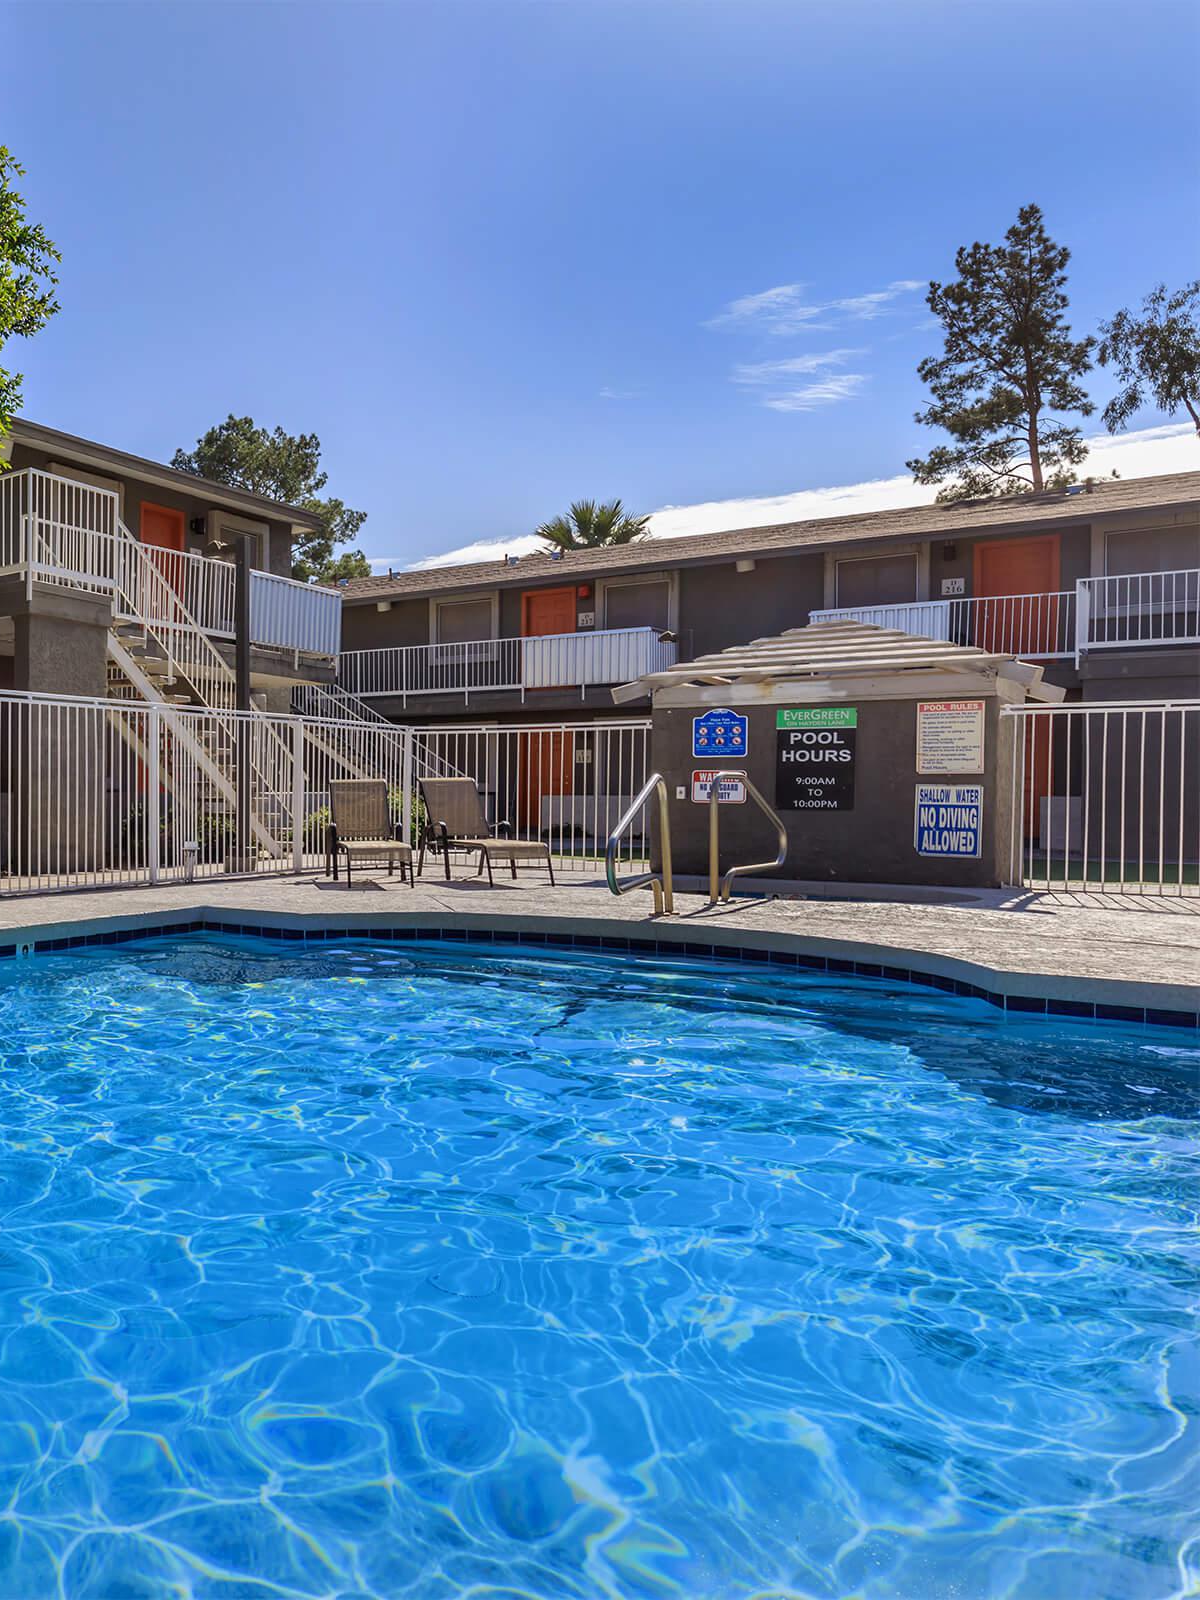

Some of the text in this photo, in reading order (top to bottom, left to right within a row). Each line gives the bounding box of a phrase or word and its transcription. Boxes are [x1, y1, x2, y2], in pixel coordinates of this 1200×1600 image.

[944, 585, 962, 593] 216
[790, 732, 845, 745] POOL
[782, 749, 852, 763] HOURS
[795, 777, 836, 785] 9:00AM
[807, 788, 823, 797] TO
[919, 788, 979, 803] SHALLOW WATER
[793, 800, 838, 808] 10:00PM
[920, 807, 978, 829] NO DIVING
[921, 830, 975, 853] ALLOWED
